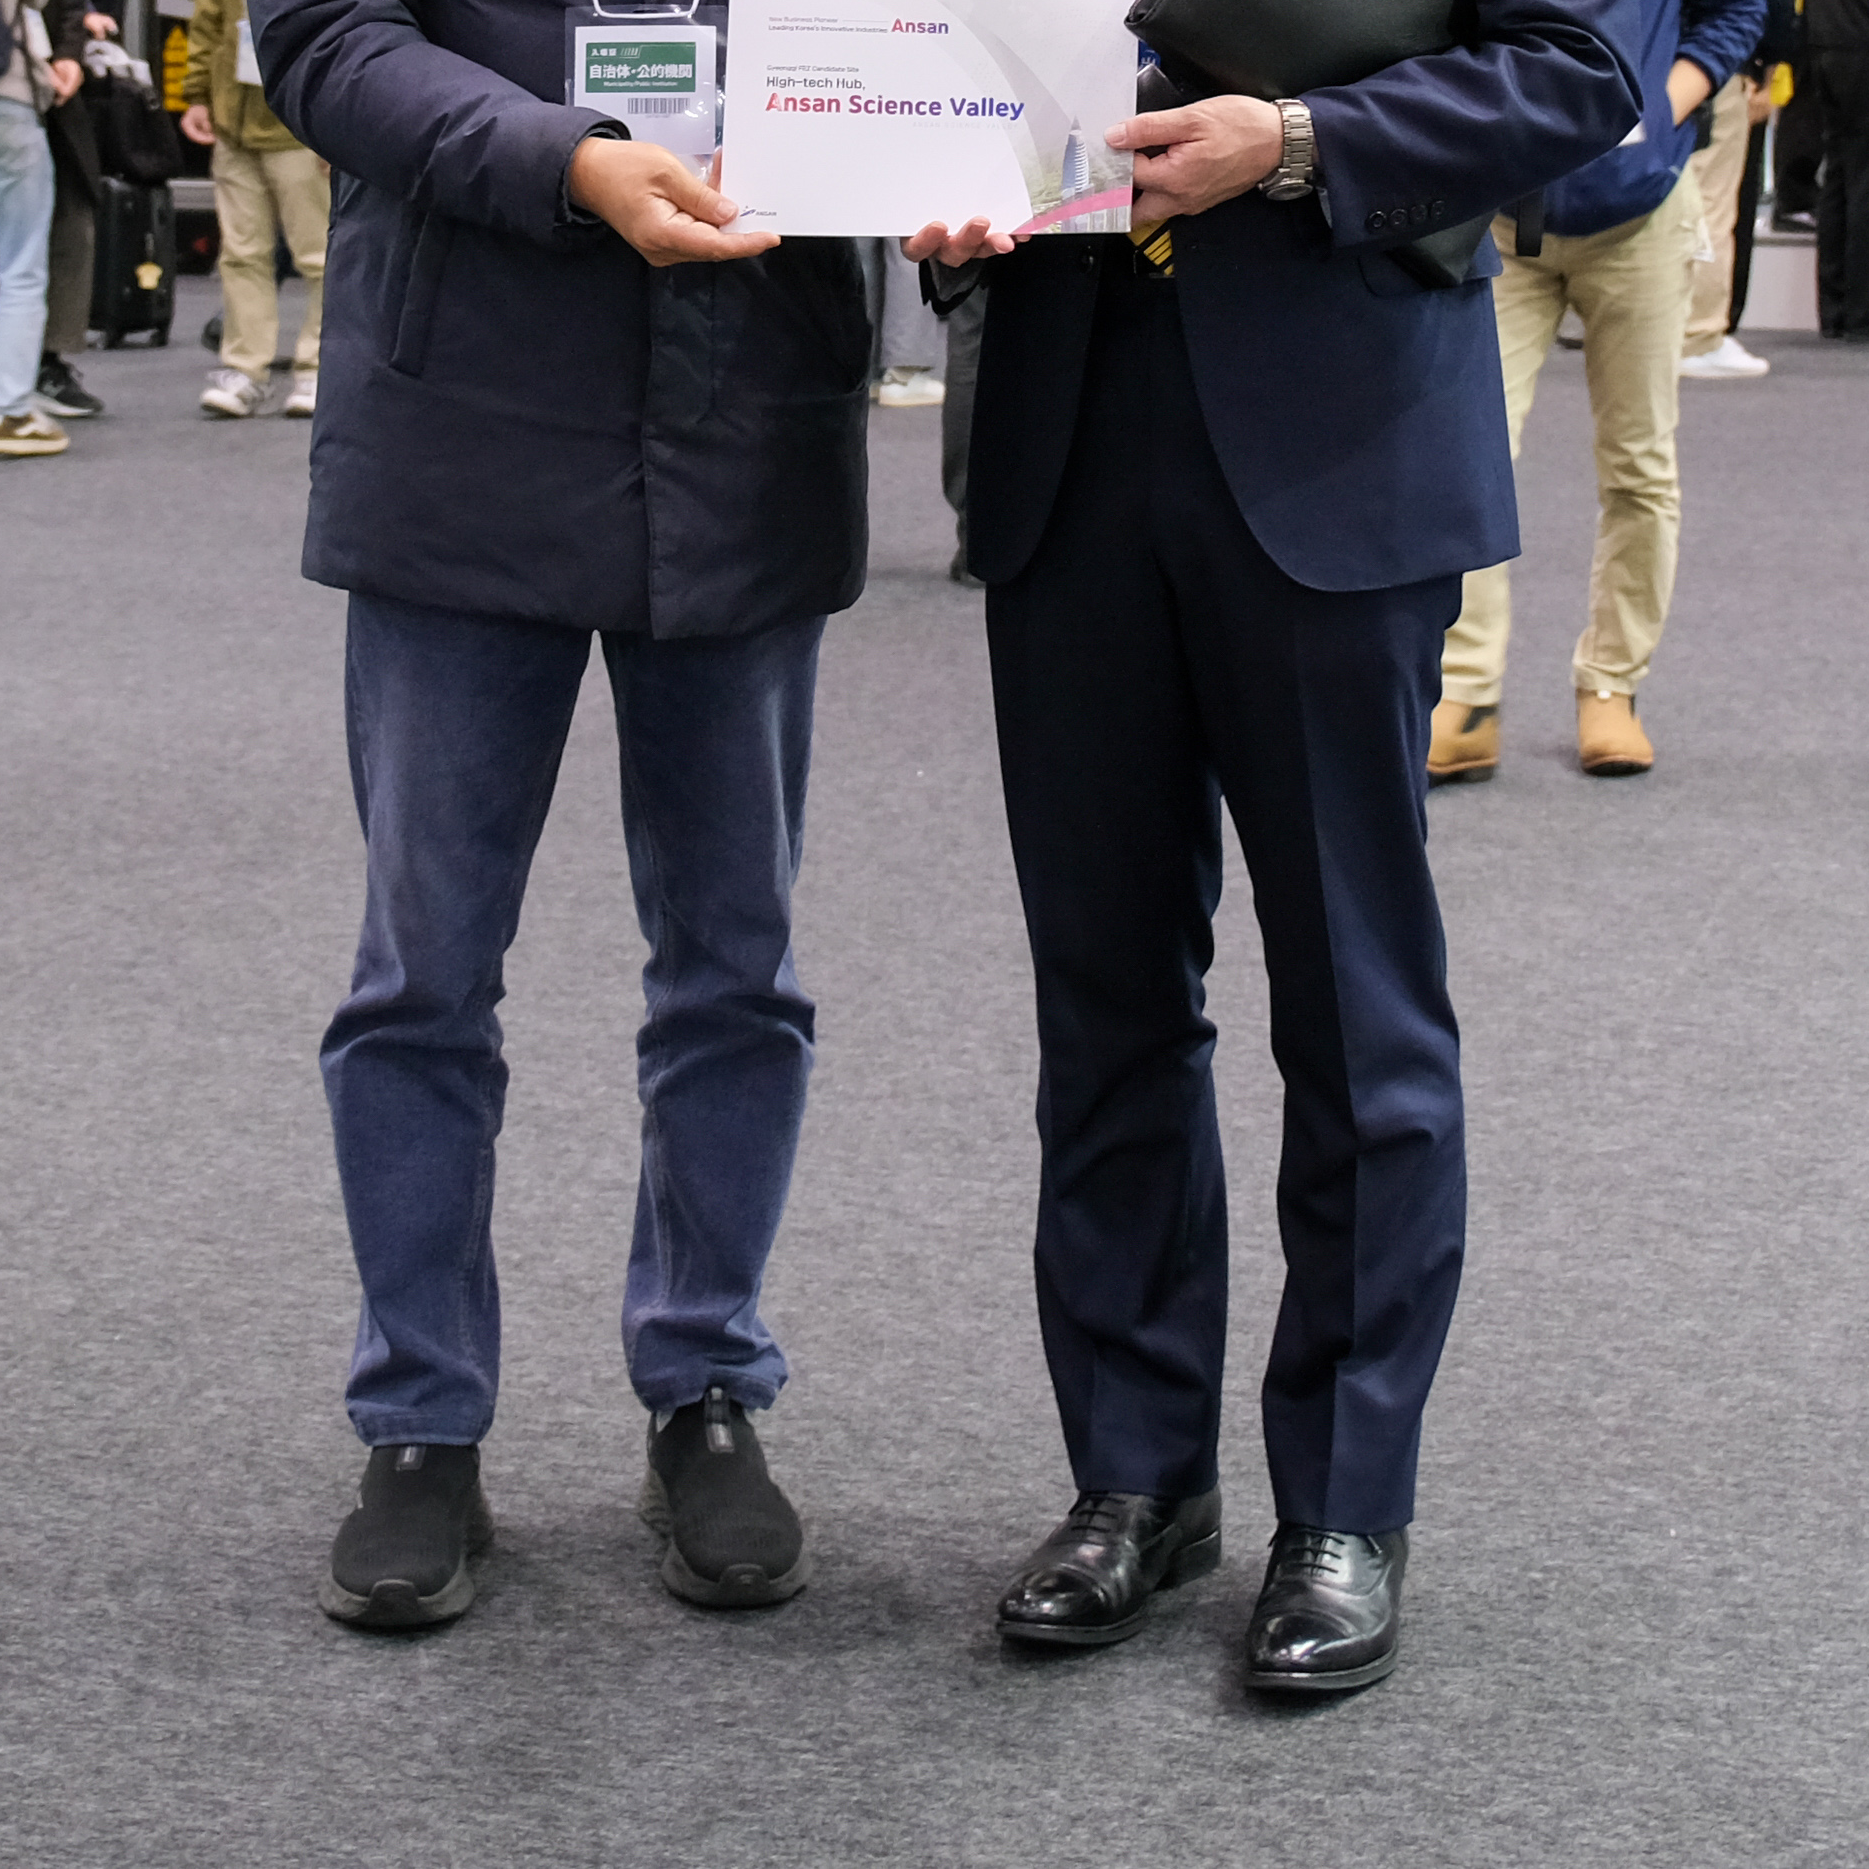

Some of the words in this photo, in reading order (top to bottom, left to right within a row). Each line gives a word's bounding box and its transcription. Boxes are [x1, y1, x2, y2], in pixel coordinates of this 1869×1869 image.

[891, 18, 949, 34] Ansan
[766, 76, 832, 90] High-tech
[836, 78, 866, 91] Hub,
[765, 92, 841, 113] Ansan
[848, 95, 942, 116] Science
[949, 98, 1025, 121] Valley
